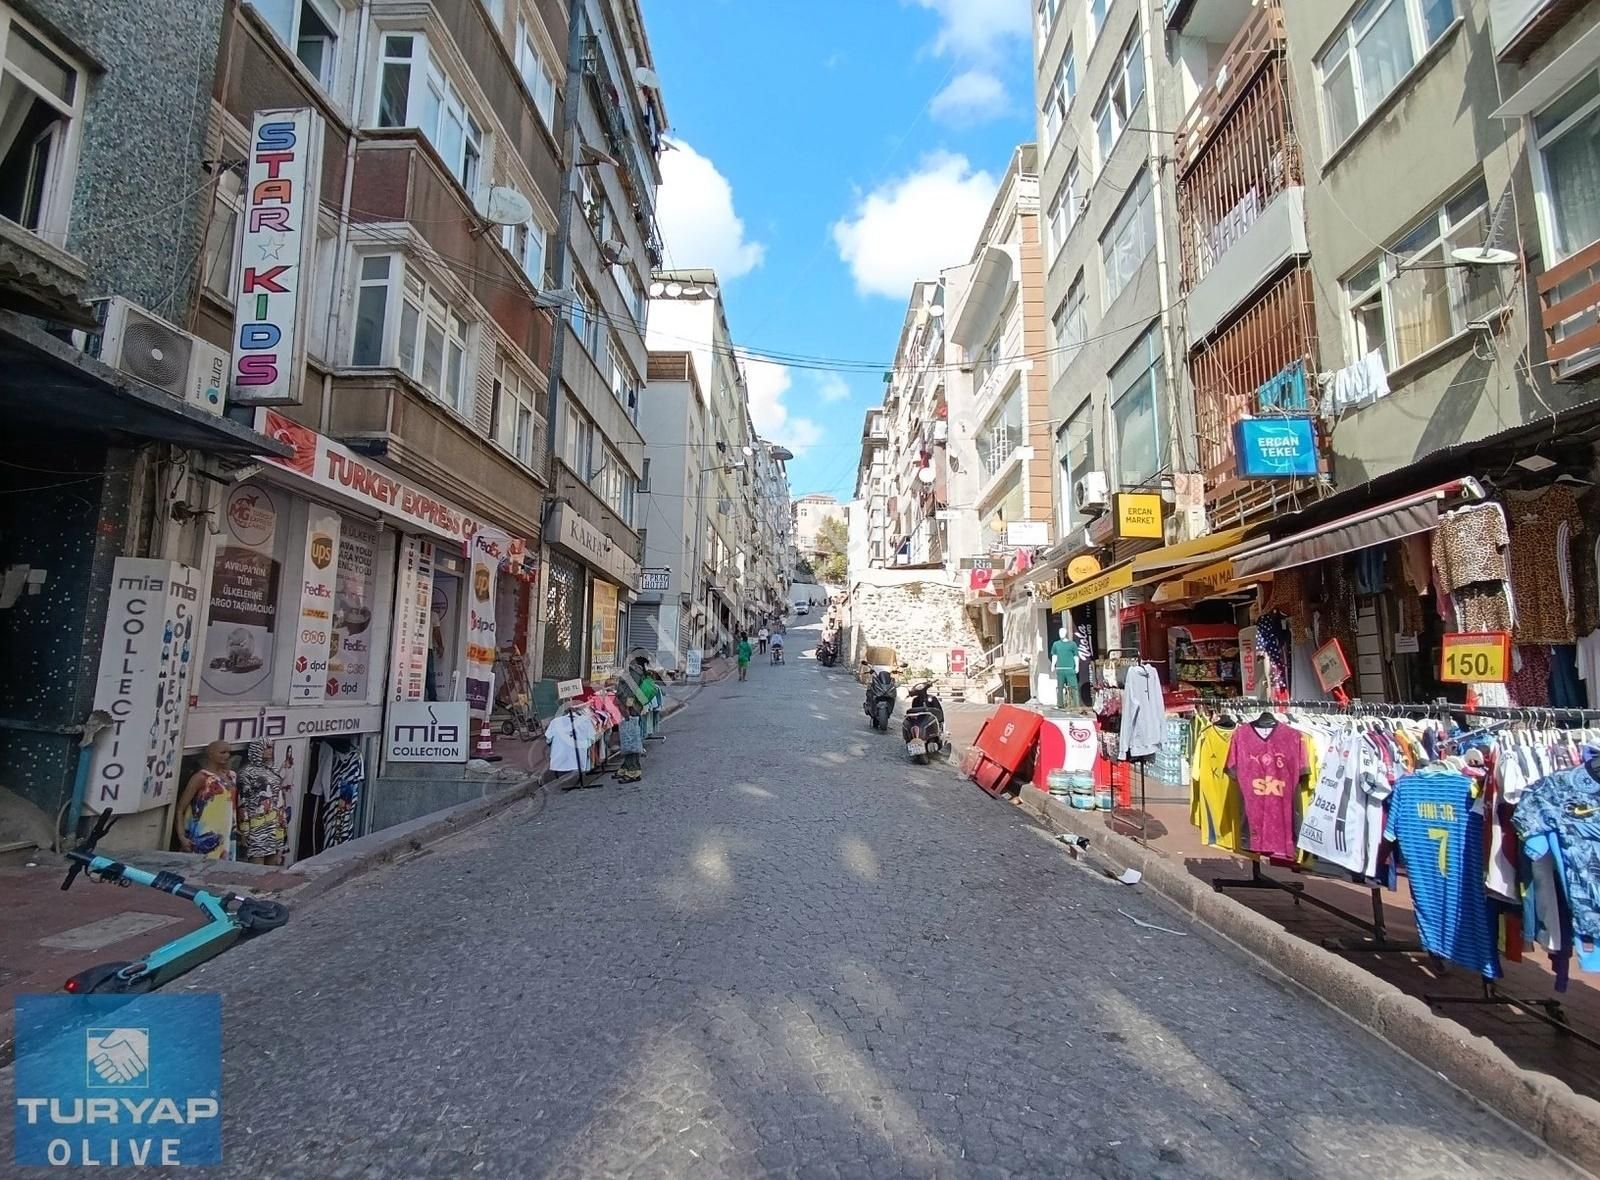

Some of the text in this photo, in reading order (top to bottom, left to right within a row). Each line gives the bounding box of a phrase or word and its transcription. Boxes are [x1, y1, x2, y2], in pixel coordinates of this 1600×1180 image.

[236, 120, 297, 387] STAR KIDS
[210, 357, 223, 389] aura
[1258, 436, 1300, 458] ERCAN TEKEL
[326, 449, 402, 506] TURKEY
[401, 486, 461, 536] EXPRESS
[1125, 516, 1155, 525] MARKET
[1127, 507, 1153, 516] ERCAN
[312, 541, 331, 565] ups
[339, 550, 353, 561] ARA
[340, 541, 354, 551] AVA
[475, 535, 501, 559] FedEx
[236, 575, 253, 586] TÜM
[304, 580, 331, 598] FedEx
[210, 598, 232, 609] ARGO
[343, 638, 367, 652] FedEx
[310, 660, 327, 672] dpd
[100, 575, 164, 802] mia COLLECTION
[153, 577, 197, 797] mia COLLECTION
[341, 682, 358, 695] dpd
[218, 711, 361, 741] mia COLLECTION
[394, 716, 459, 743] mia
[392, 747, 459, 757] COLLECTION
[1427, 827, 1449, 878] 7
